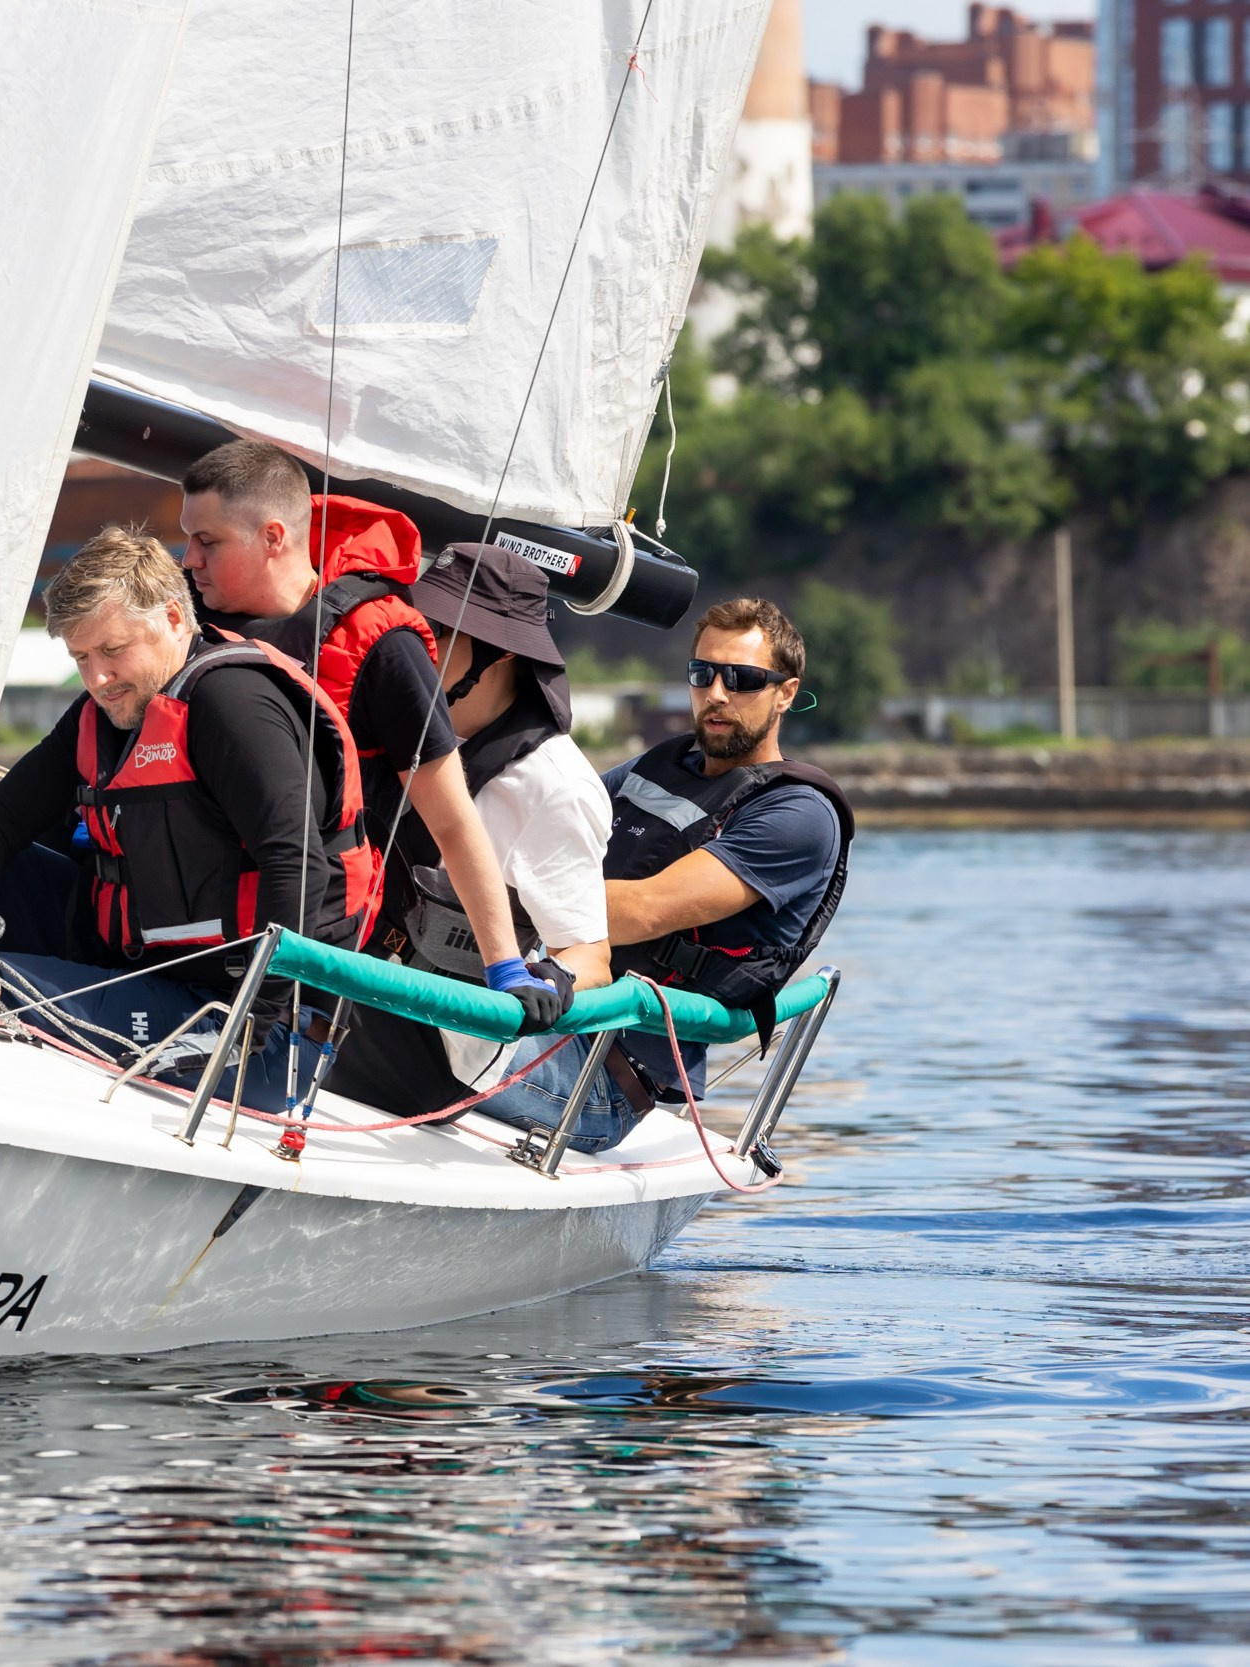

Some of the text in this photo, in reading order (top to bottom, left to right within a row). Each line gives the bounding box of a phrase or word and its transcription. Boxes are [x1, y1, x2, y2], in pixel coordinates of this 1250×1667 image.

[498, 537, 569, 569] WIND BROTHERS
[131, 1012, 149, 1041] HH
